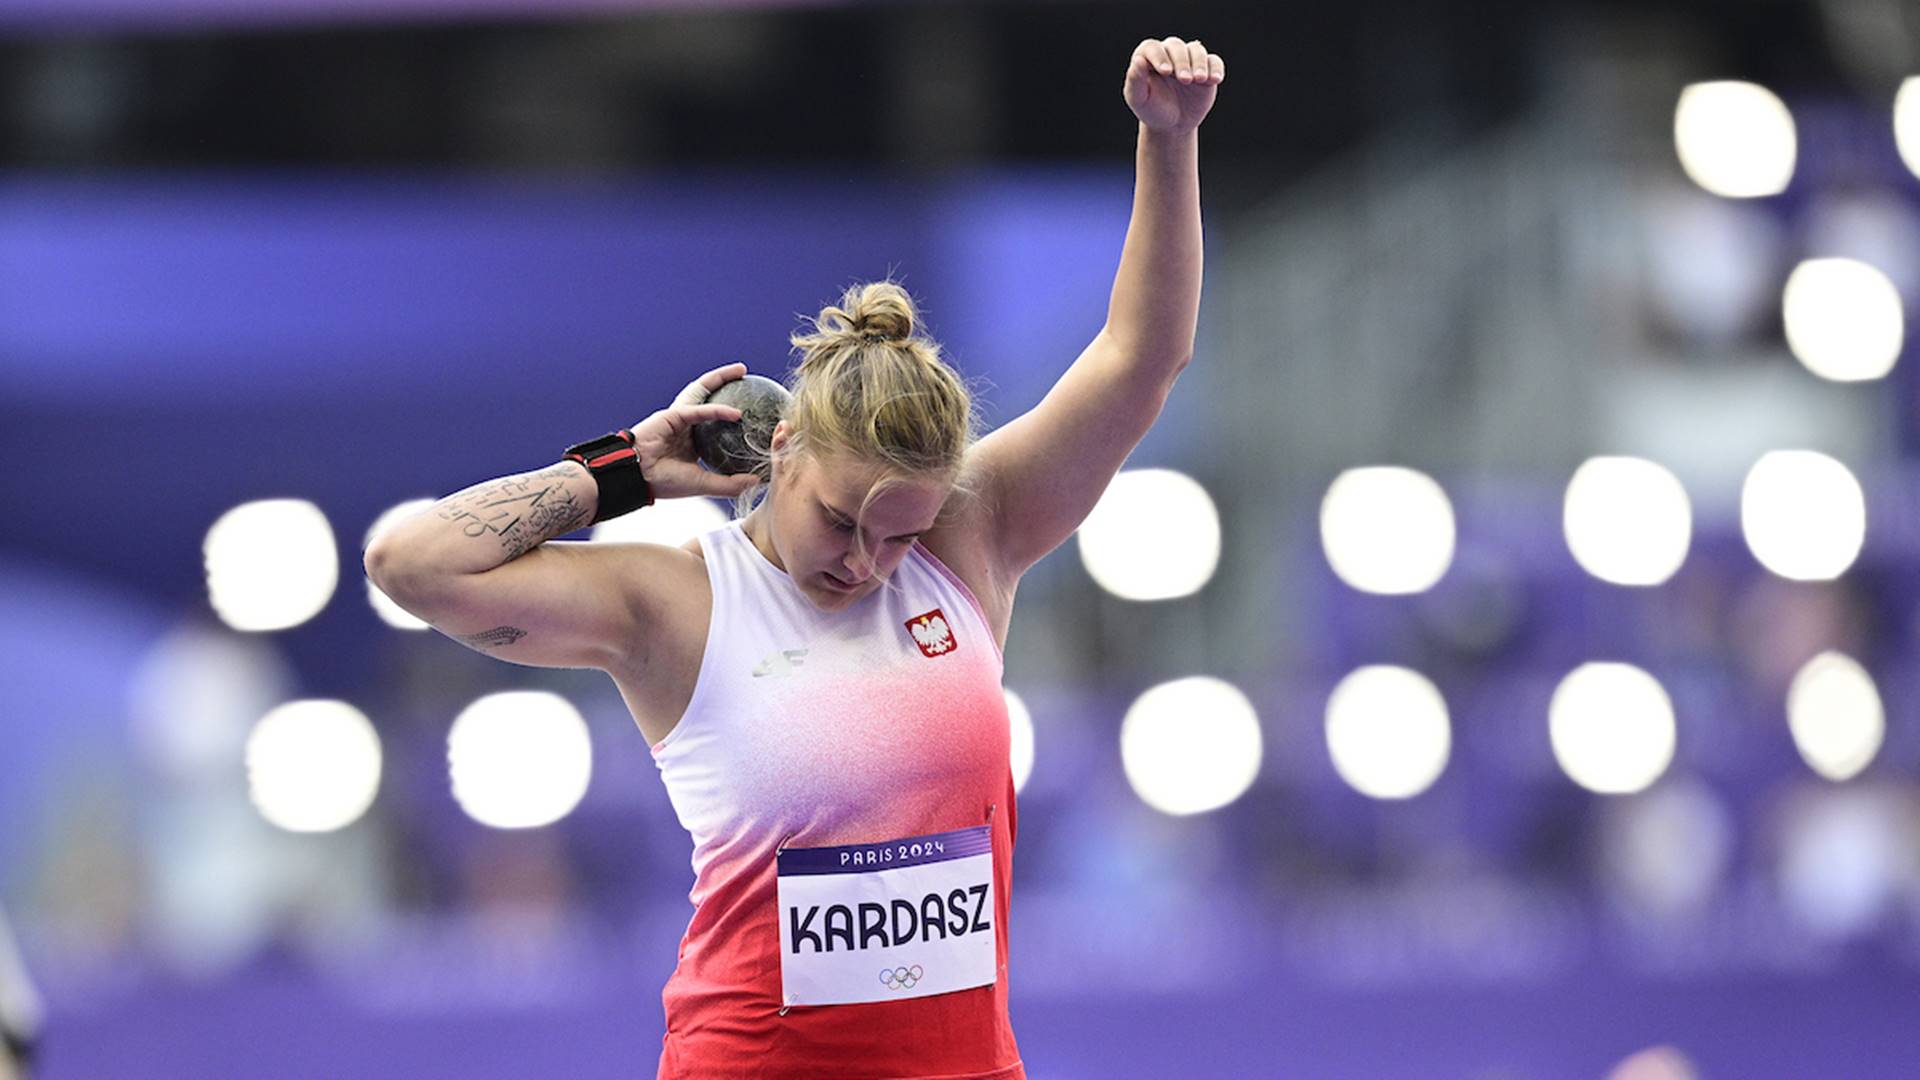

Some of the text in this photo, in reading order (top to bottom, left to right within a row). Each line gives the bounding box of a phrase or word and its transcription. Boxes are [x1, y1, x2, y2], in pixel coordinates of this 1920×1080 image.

[840, 841, 944, 866] PARIS 2024
[790, 883, 990, 954] KARDASZ
